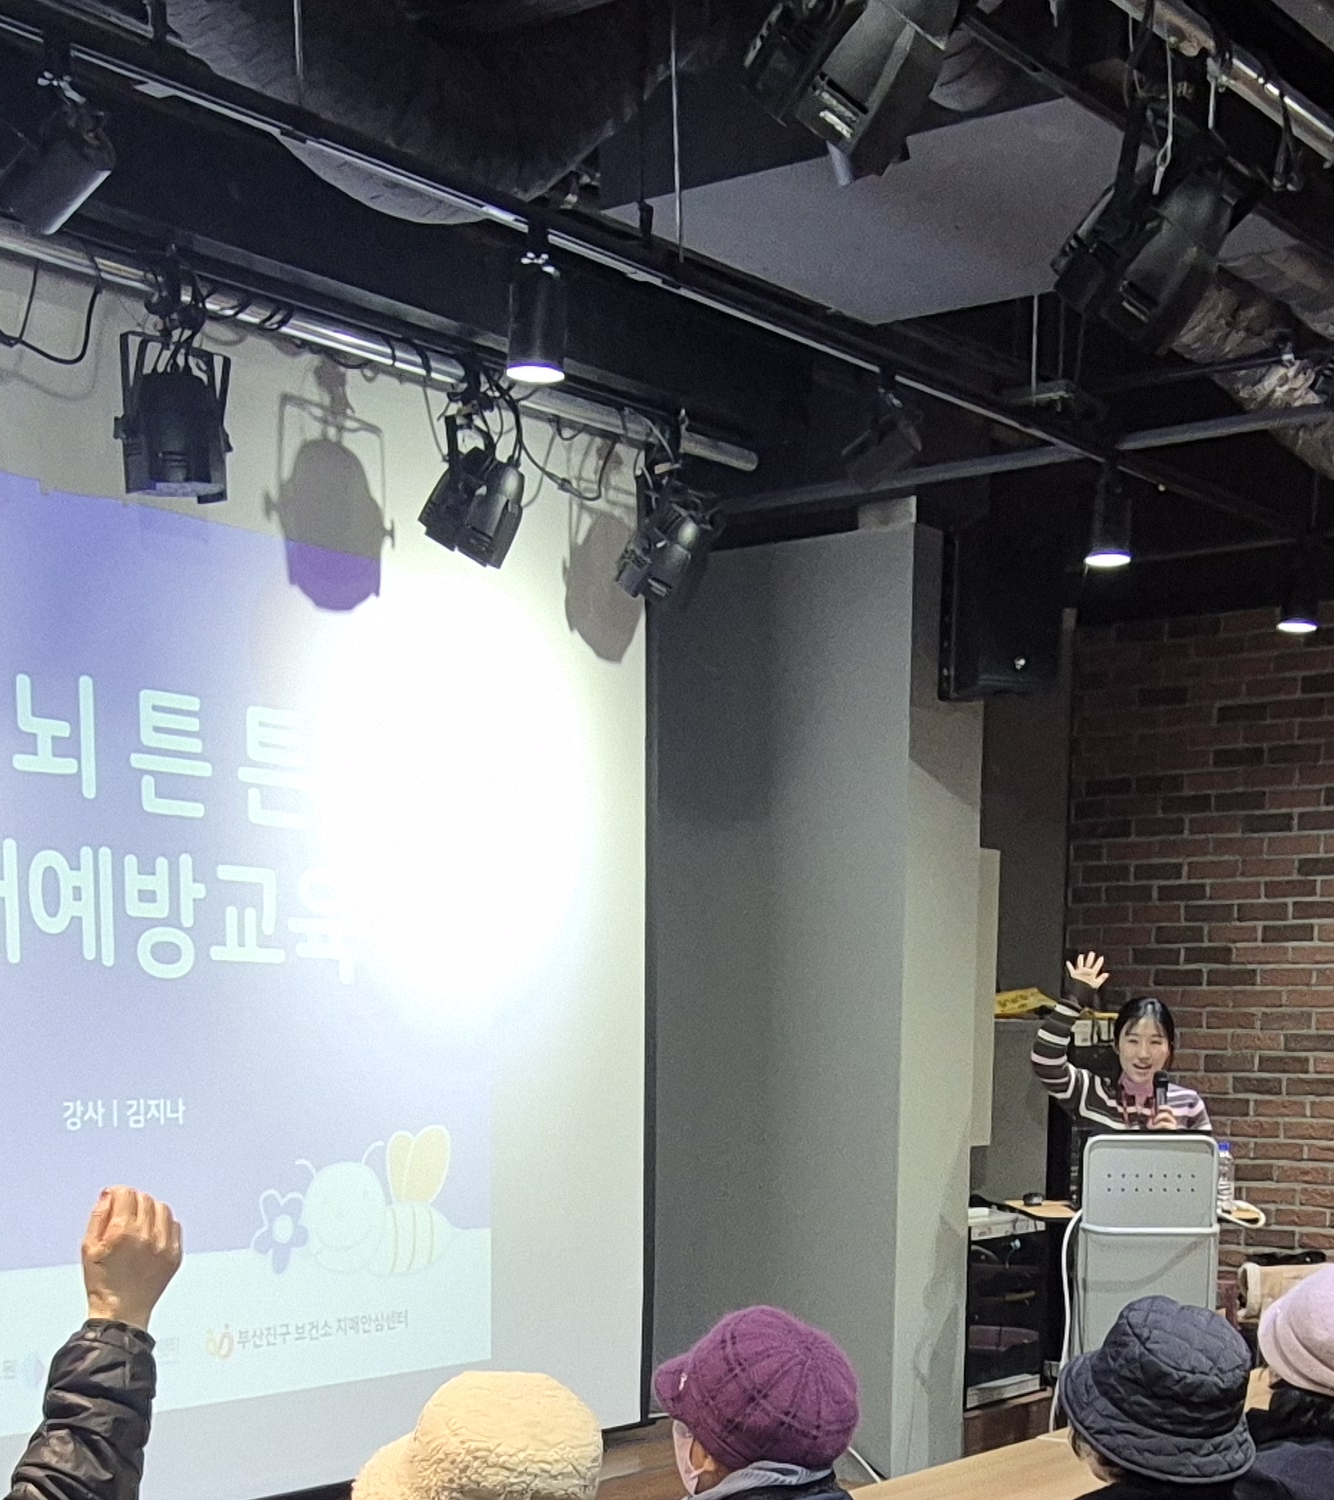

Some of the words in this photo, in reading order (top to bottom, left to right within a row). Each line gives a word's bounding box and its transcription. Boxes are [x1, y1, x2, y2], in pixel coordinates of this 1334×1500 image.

[63, 1099, 105, 1131] 강사
[126, 1098, 186, 1129] 김지나
[237, 1323, 292, 1349] 부산진구
[294, 1319, 333, 1342] 보건소
